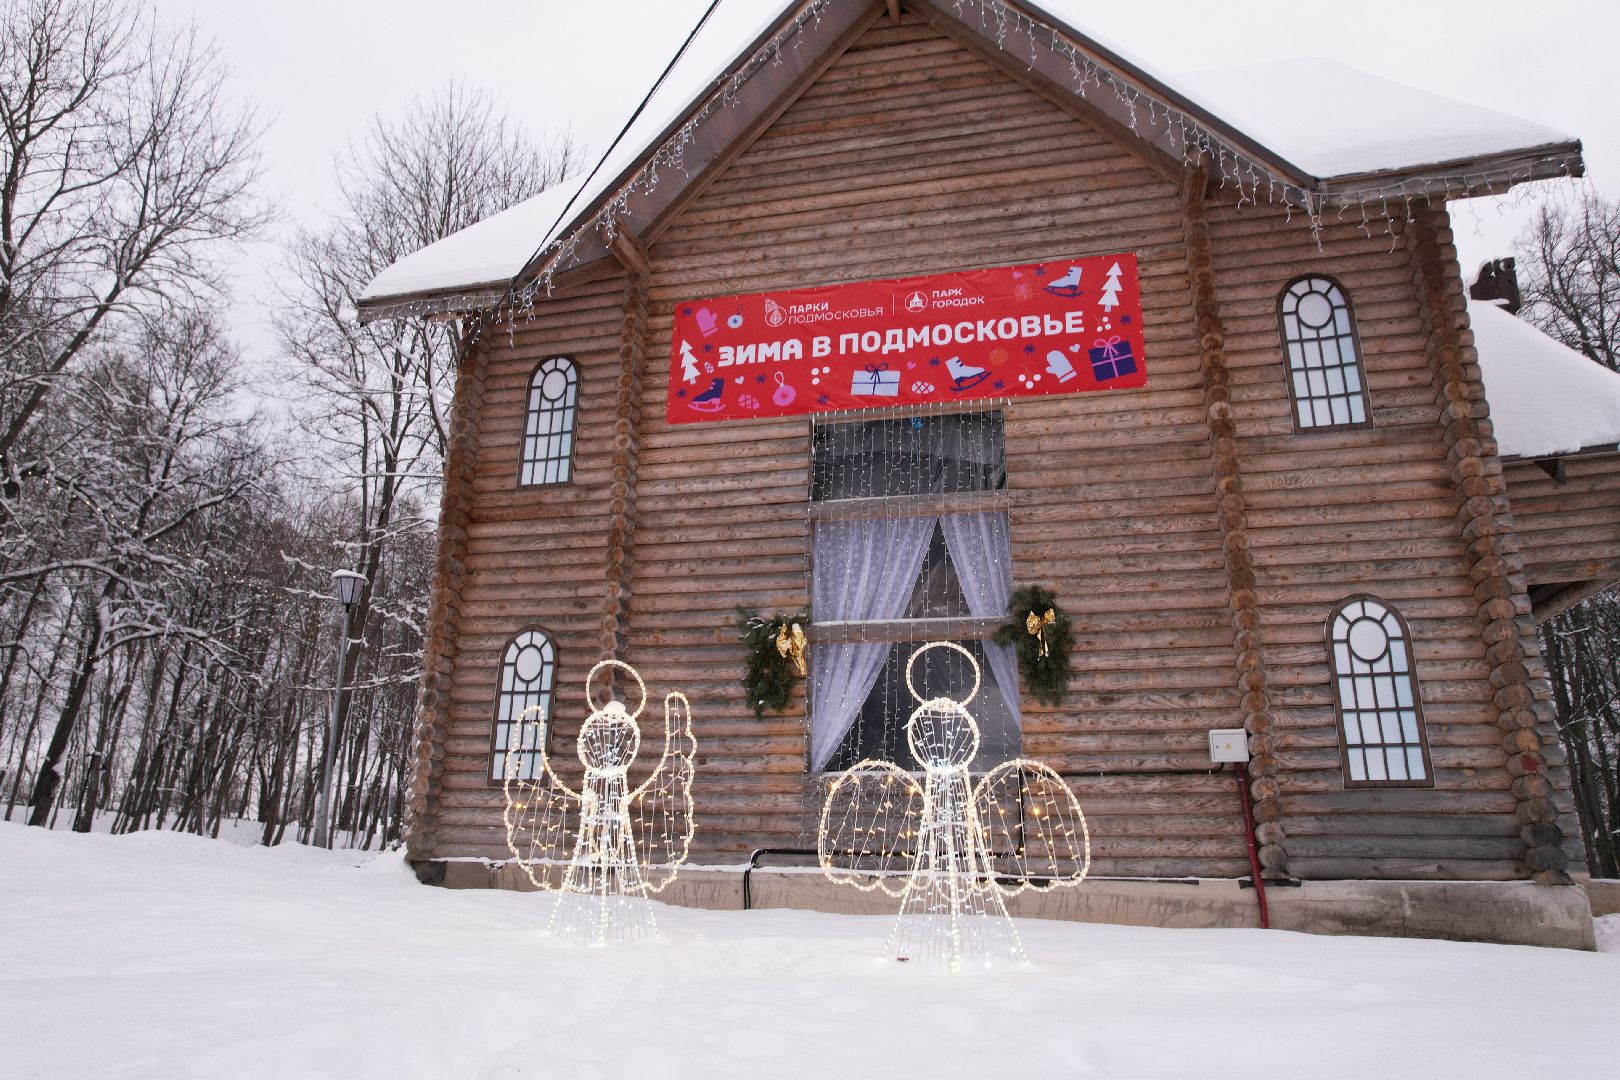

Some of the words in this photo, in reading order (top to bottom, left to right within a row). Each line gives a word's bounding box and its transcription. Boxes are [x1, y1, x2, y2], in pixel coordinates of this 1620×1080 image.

[932, 287, 963, 299] ПАРК
[789, 302, 829, 314] ПАРКИ
[932, 295, 985, 309] ГОРОДОК
[788, 306, 884, 325] ПОДМОСКОВЬЯ
[717, 338, 803, 368] ЗИМА
[812, 335, 832, 358] В
[839, 310, 1085, 356] ПОДМОСКОВЬЕ
